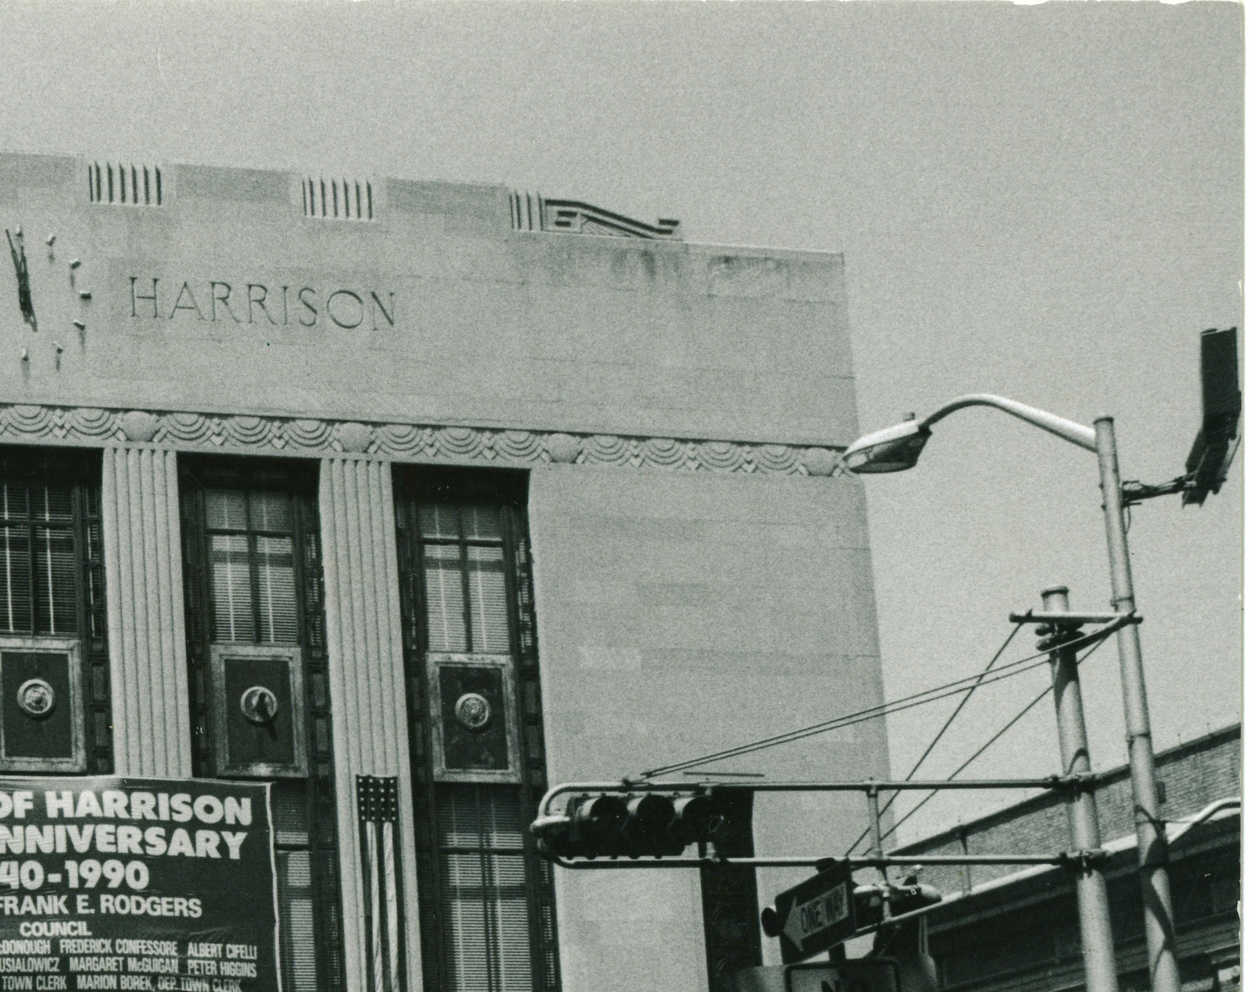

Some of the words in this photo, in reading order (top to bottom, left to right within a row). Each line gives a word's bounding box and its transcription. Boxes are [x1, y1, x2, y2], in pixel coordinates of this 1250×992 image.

[129, 275, 396, 332] HARRISON
[45, 790, 252, 826] HARRISON
[77, 895, 95, 914] E.
[100, 894, 202, 918] RODGERS
[800, 899, 824, 934] ONE
[19, 921, 92, 937] COUNCIL
[60, 939, 113, 954] FREDERICK
[115, 939, 178, 956] CONFESSORE
[187, 942, 223, 958] ALBERT
[226, 944, 257, 960] CIFELLI
[69, 957, 124, 972] MARGARET
[127, 957, 178, 974] McGUIGAN
[187, 959, 217, 976] PETER
[220, 961, 257, 978] HIGGINS
[2, 976, 32, 990] TOWN
[36, 975, 67, 990] CLERK
[76, 975, 117, 990] MARION
[181, 977, 210, 992] TOWN
